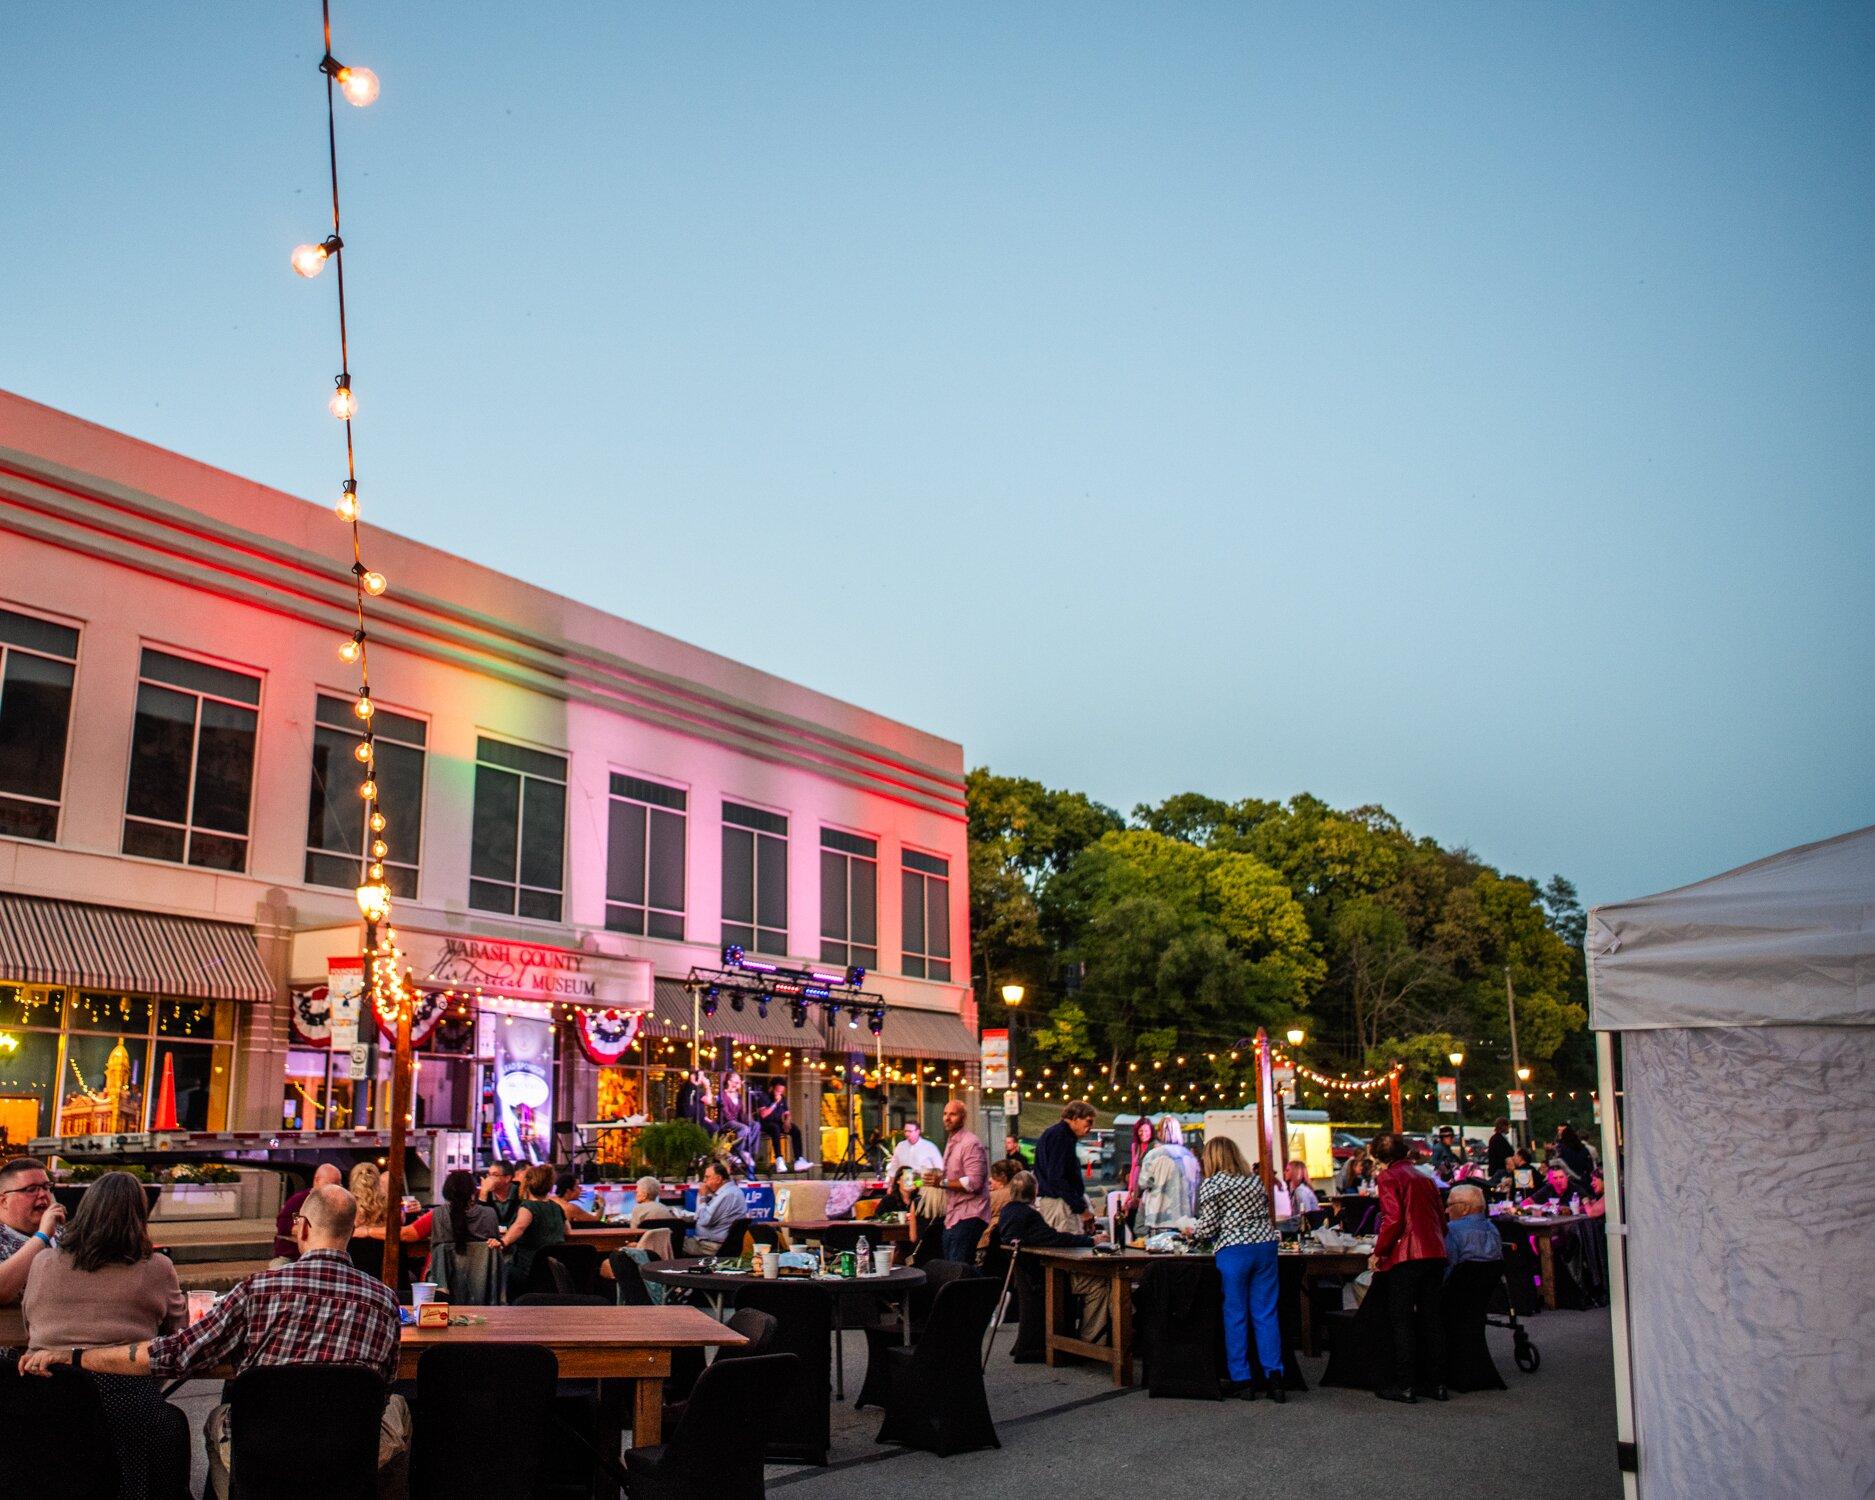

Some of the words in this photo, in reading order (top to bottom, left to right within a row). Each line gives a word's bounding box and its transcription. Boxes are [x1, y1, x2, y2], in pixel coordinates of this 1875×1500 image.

[445, 938, 510, 963] WABASH
[520, 950, 585, 973] COUNTY
[532, 974, 596, 997] MUSEUM
